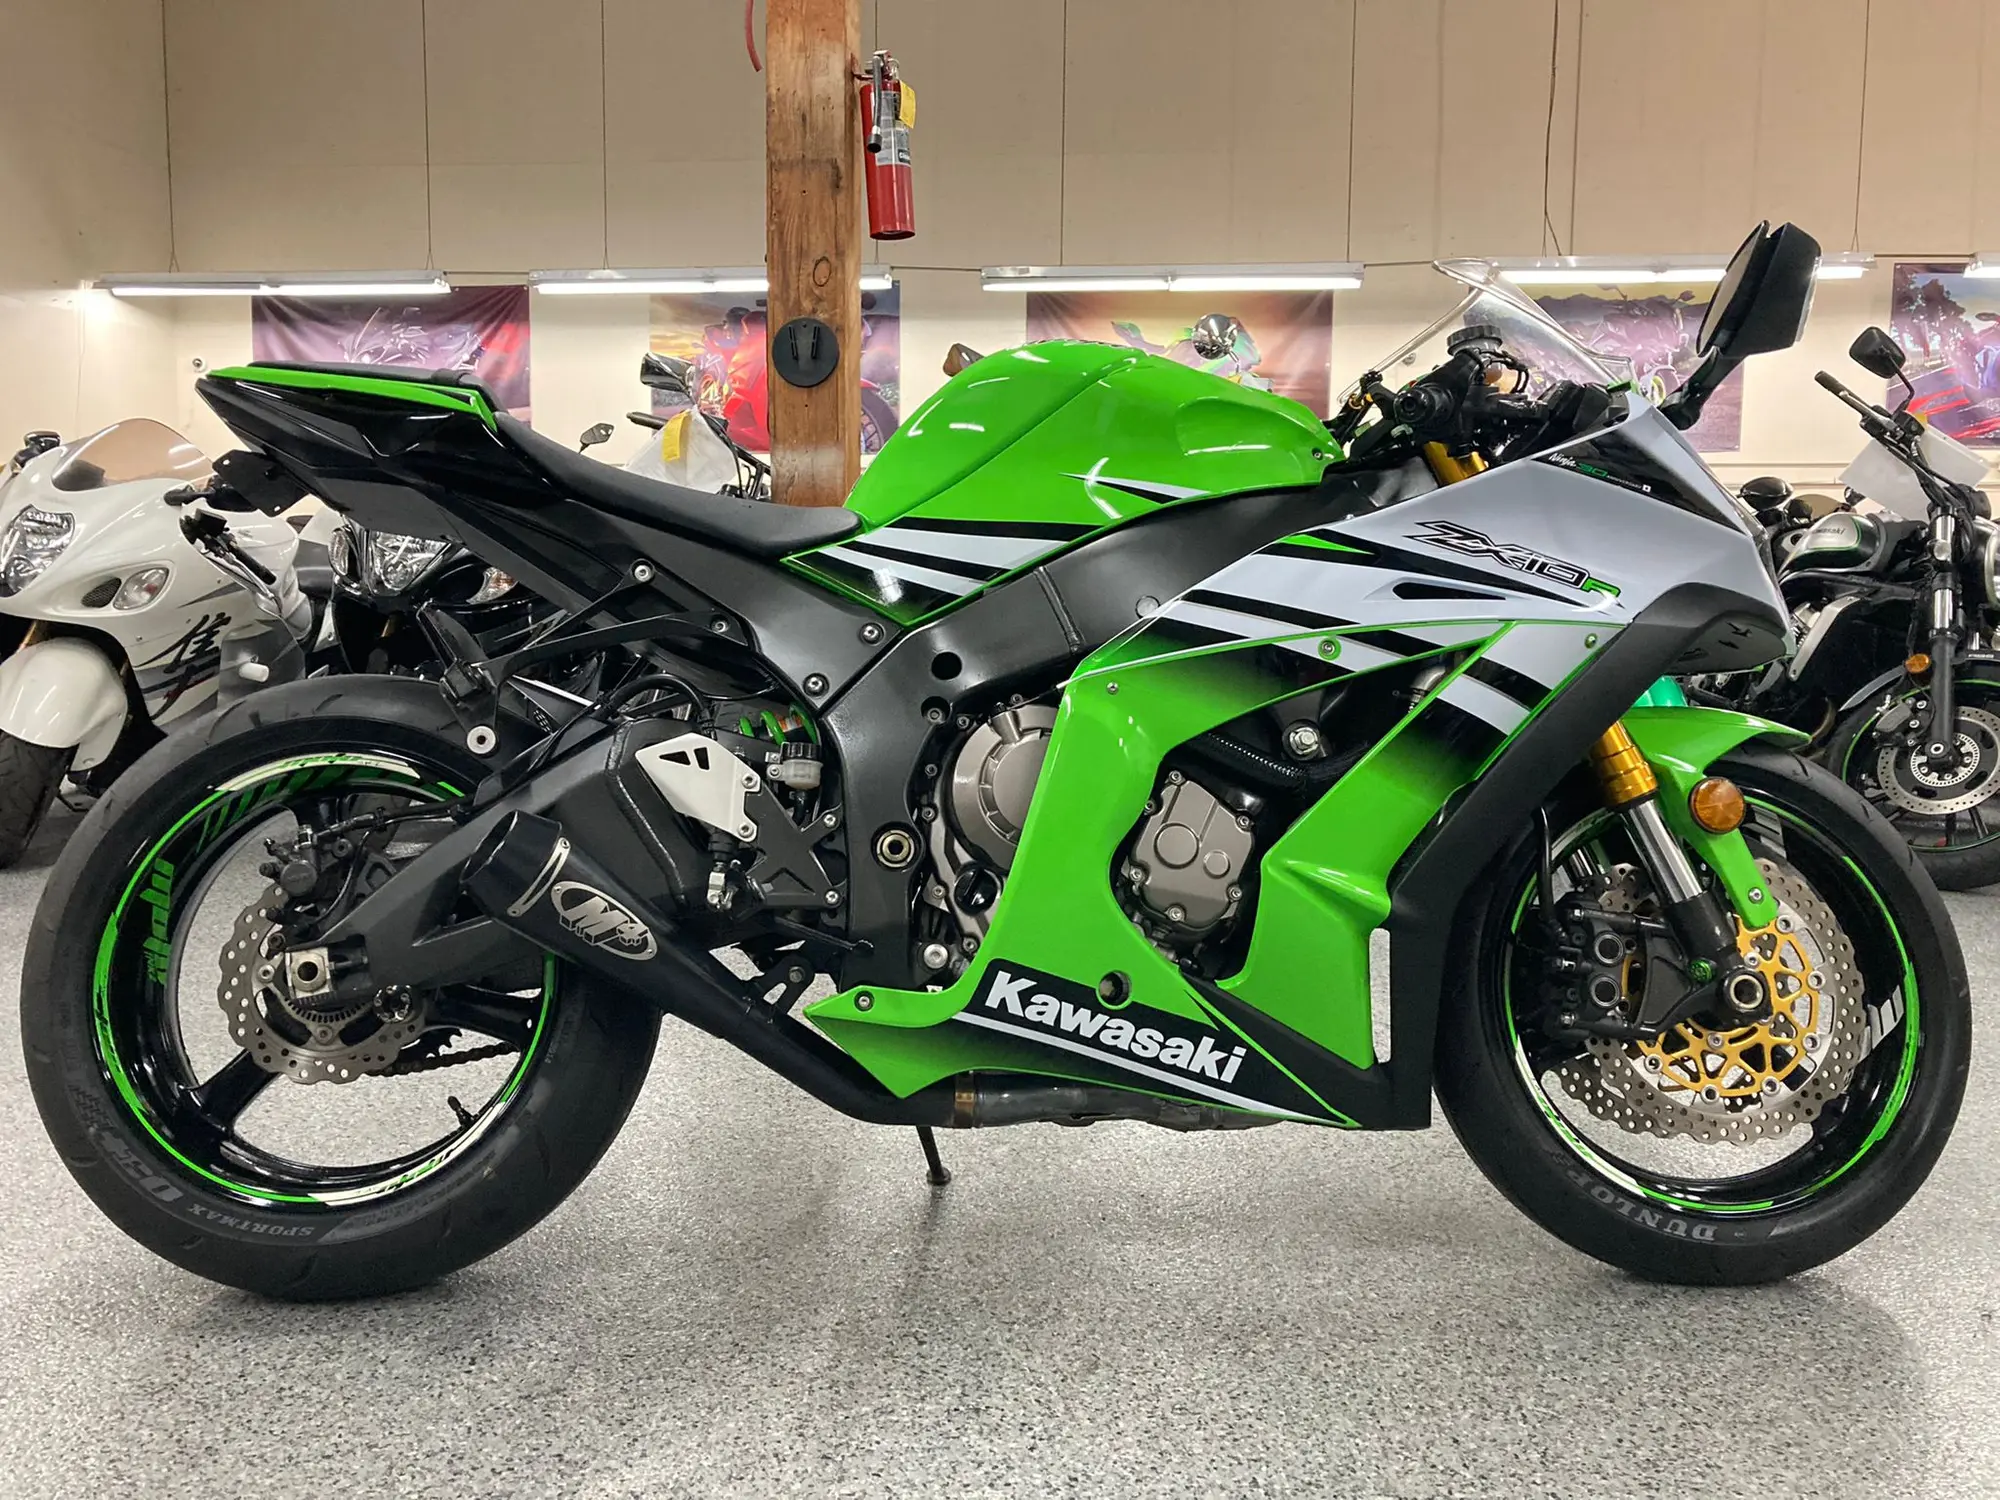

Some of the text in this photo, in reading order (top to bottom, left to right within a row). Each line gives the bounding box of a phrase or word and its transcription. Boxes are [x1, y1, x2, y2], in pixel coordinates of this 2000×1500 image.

[1549, 453, 1577, 467] Ninja
[1577, 463, 1608, 477] 30
[559, 895, 649, 947] M4
[984, 970, 1247, 1084] Kawasaki
[187, 1203, 315, 1237] SPORTMAX
[1565, 1169, 1719, 1242] DUNLOP
